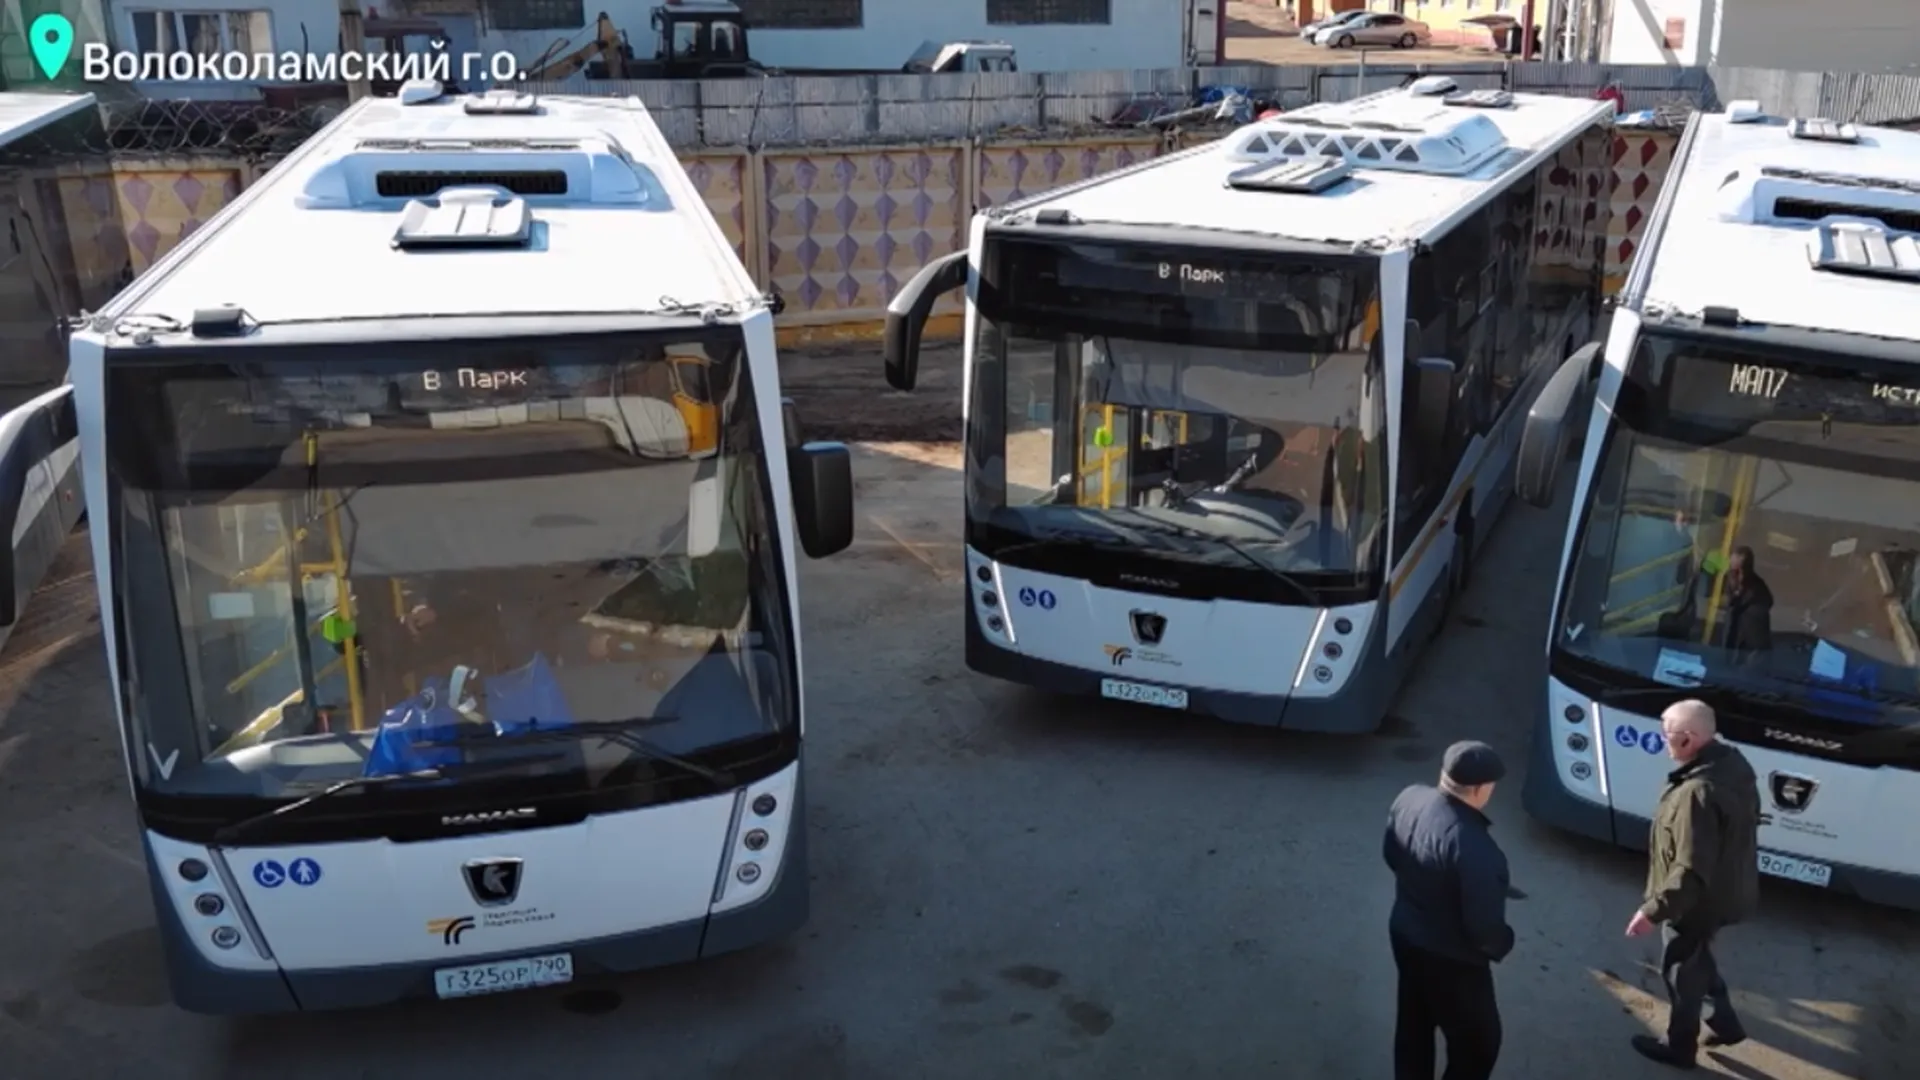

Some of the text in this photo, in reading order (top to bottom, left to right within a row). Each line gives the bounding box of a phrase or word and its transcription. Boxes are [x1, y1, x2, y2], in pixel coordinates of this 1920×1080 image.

[1180, 263, 1225, 284] Парк
[422, 367, 528, 391] В Парк
